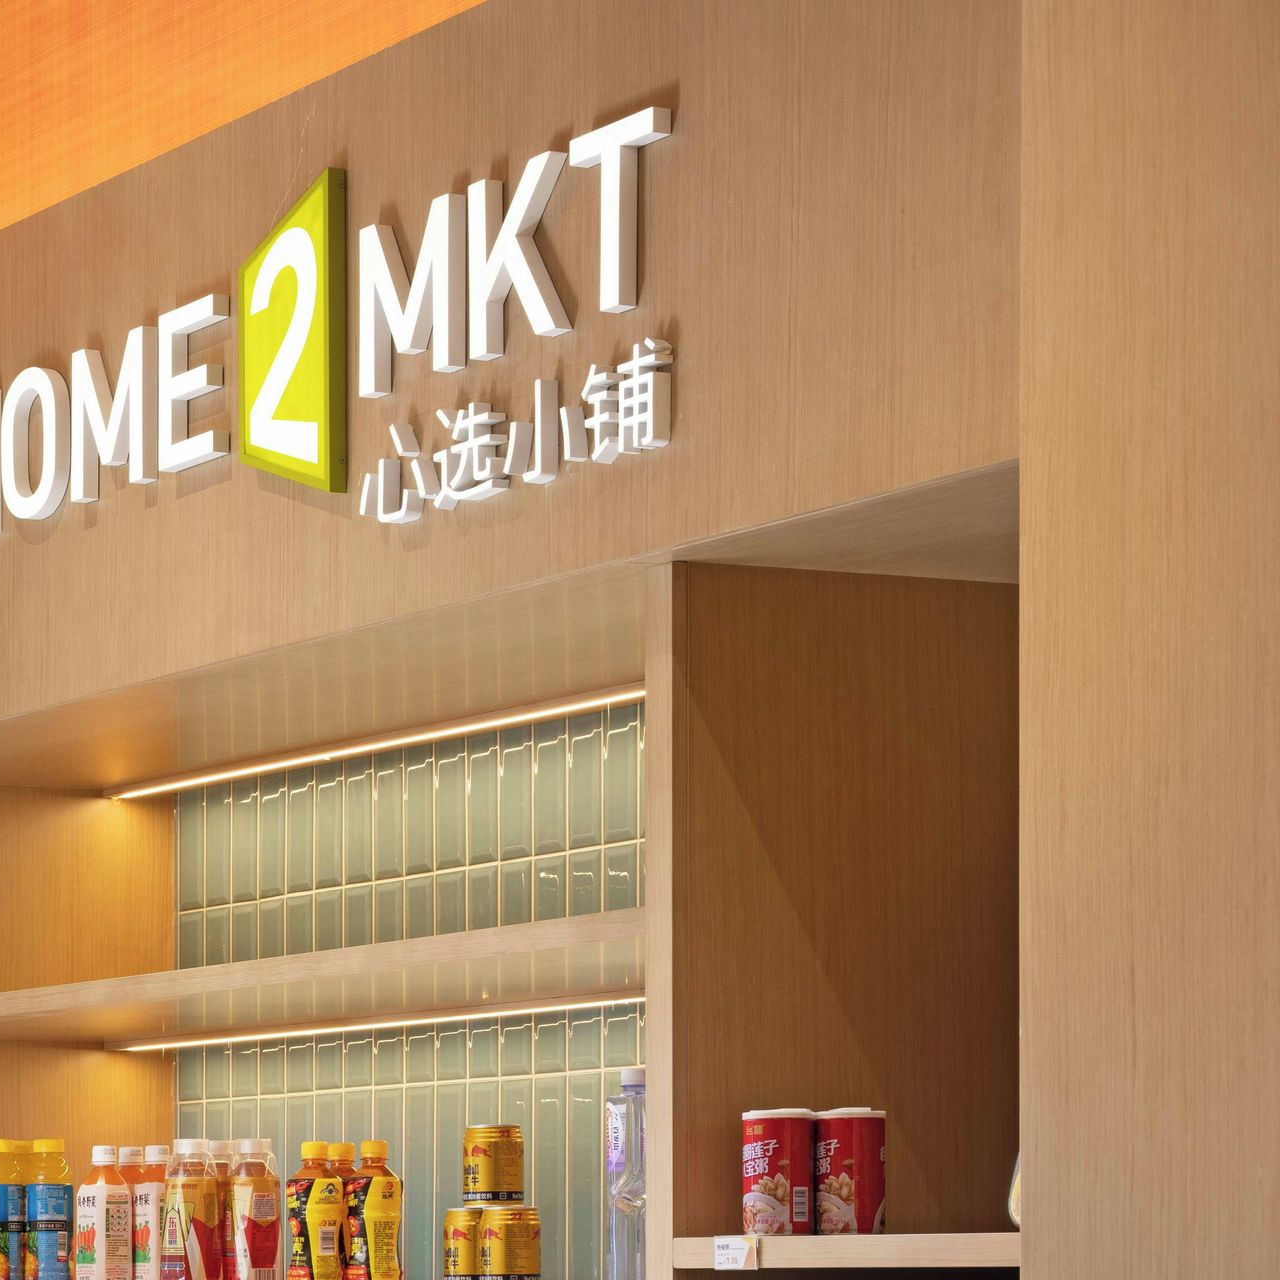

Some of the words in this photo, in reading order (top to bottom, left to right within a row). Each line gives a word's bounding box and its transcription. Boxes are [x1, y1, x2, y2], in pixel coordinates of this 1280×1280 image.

[250, 227, 319, 465] 2
[359, 106, 672, 399] MKT
[359, 338, 674, 524] 心选小铺
